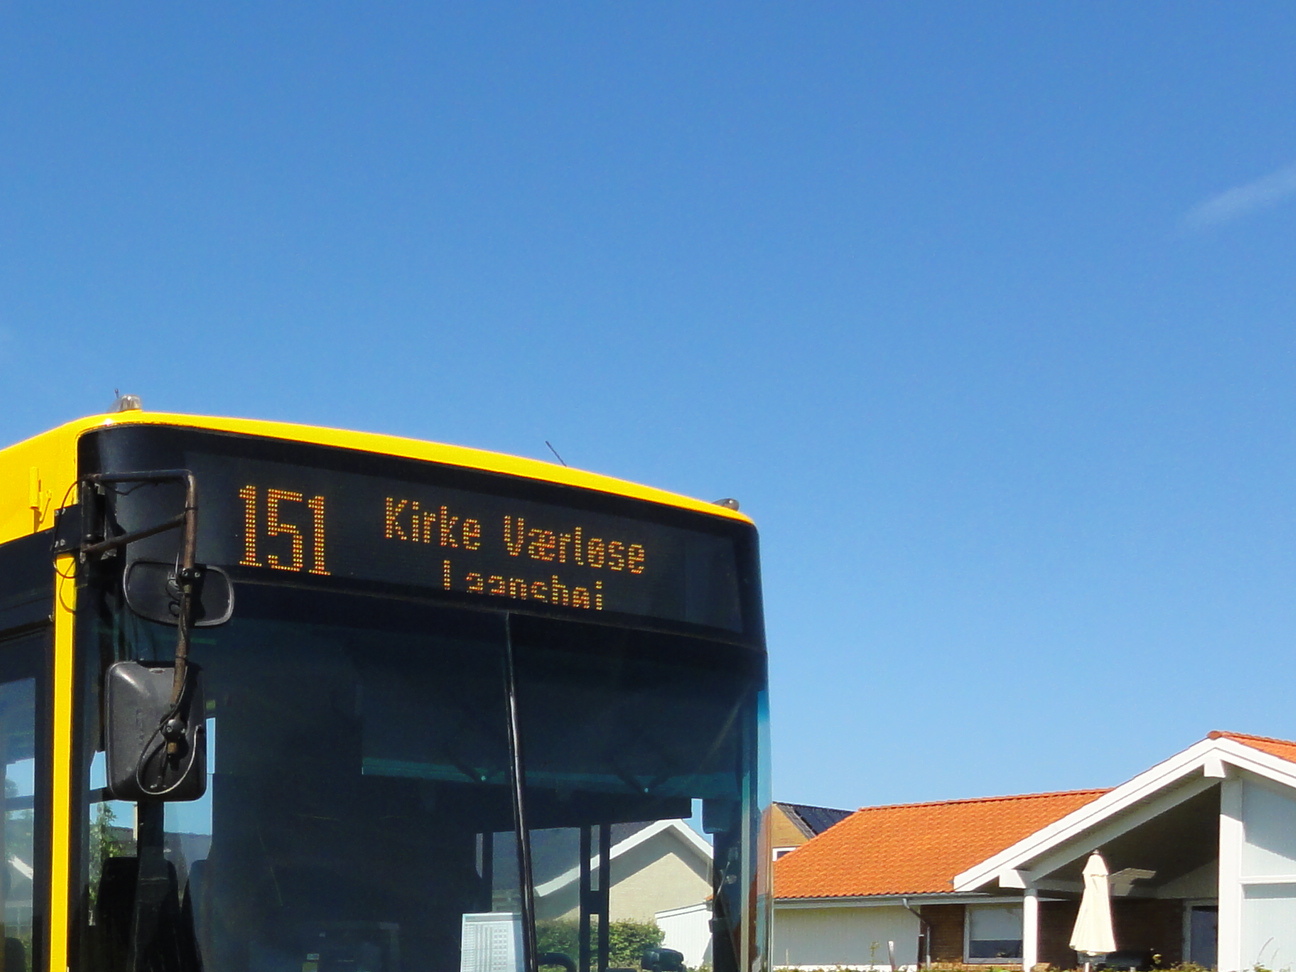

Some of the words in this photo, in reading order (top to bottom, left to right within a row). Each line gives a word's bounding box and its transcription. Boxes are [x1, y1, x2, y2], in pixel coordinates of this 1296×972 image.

[239, 485, 331, 576] 151
[385, 497, 481, 551] Kirke
[504, 515, 645, 574] Værløse
